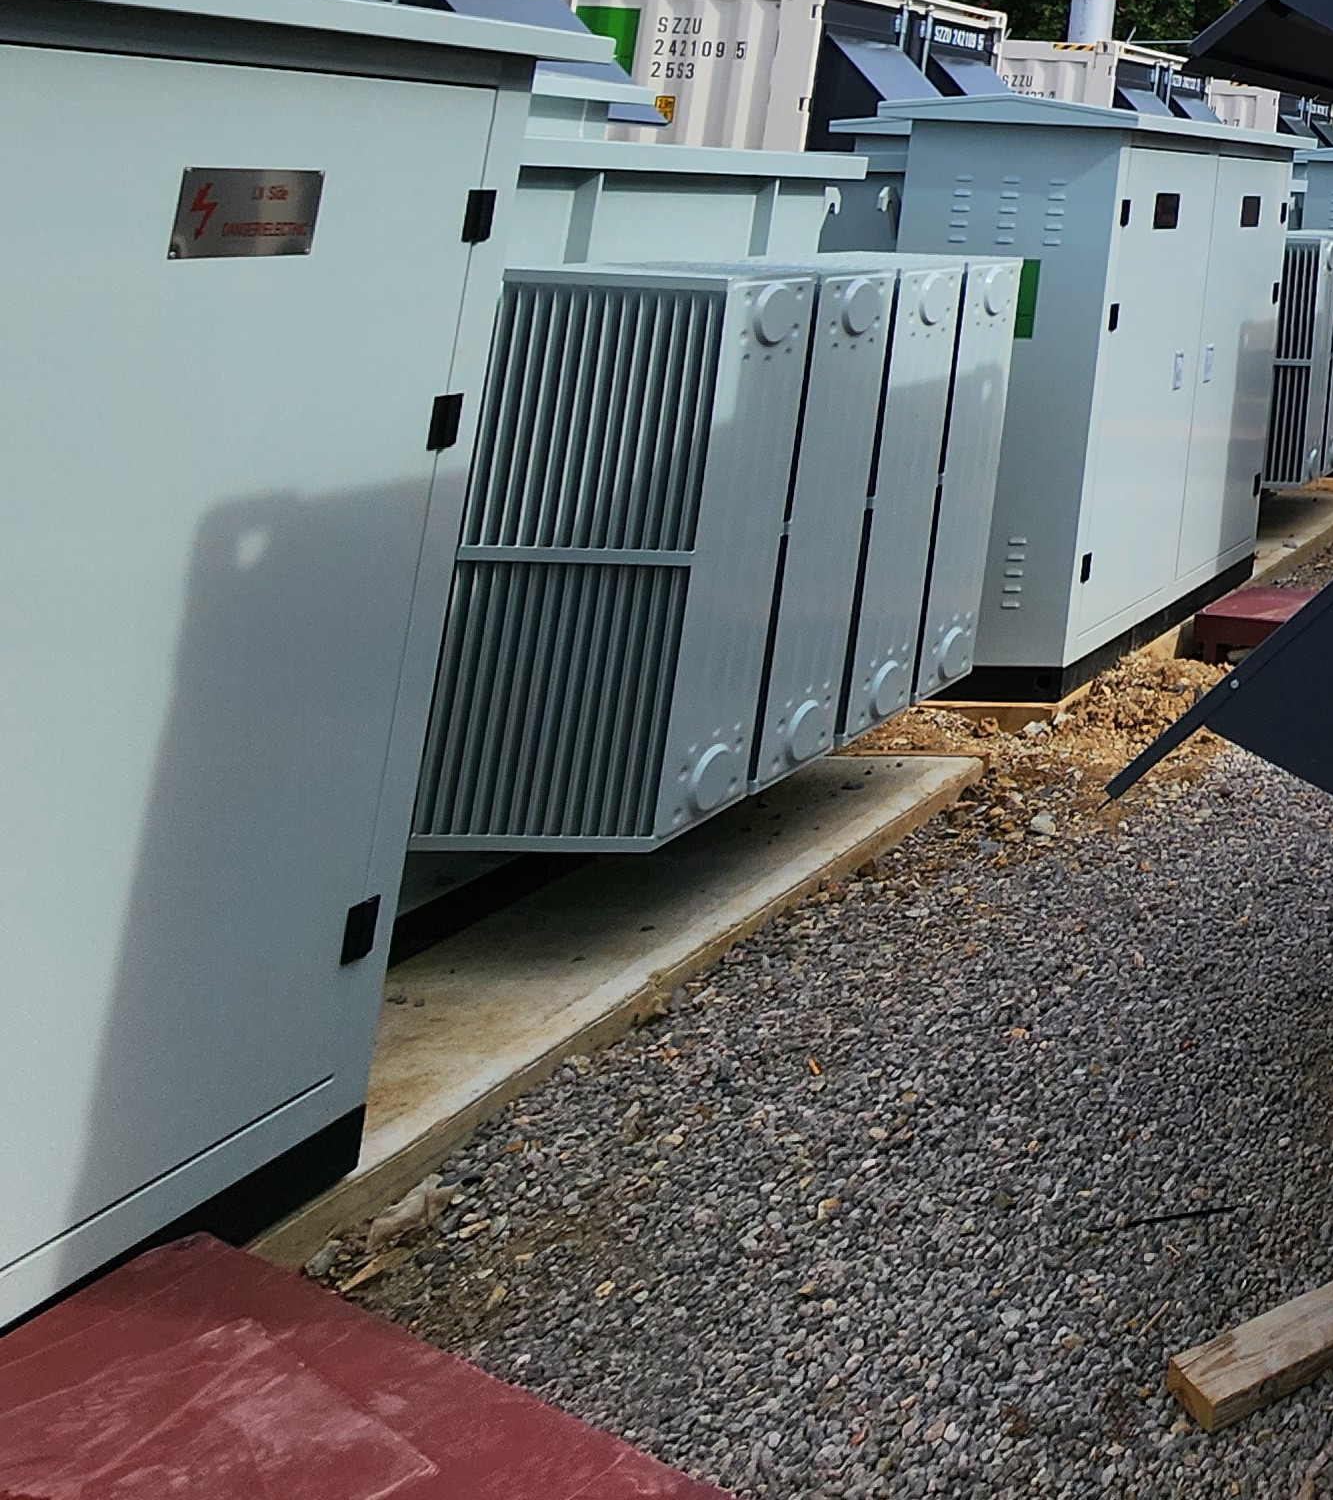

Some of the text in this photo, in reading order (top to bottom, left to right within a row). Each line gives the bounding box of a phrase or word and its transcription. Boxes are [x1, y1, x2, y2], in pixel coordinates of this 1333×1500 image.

[657, 17, 702, 35] SZZU
[653, 39, 747, 60] 242109 5
[650, 61, 695, 79] 25S3
